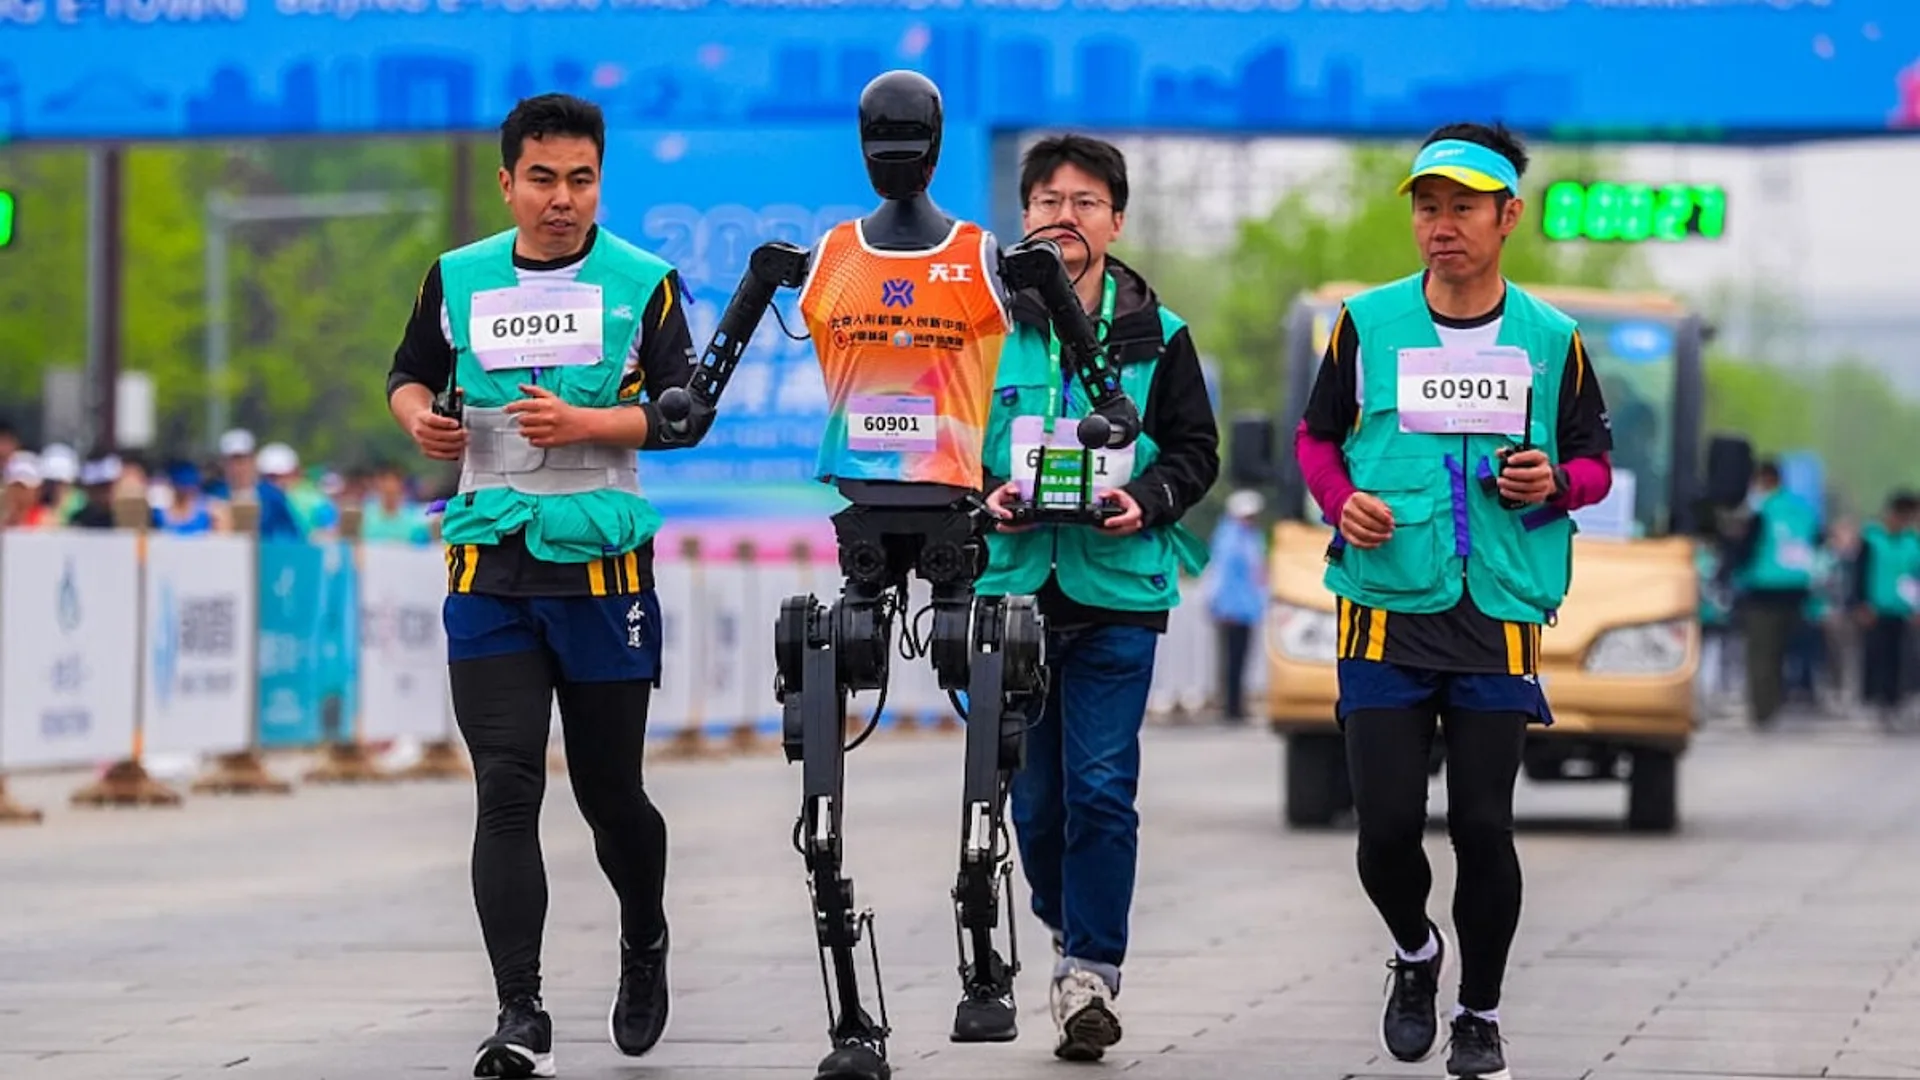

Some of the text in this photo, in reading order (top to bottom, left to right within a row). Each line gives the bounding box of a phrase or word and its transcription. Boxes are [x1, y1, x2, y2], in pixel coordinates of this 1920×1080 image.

[643, 203, 866, 286] 202
[928, 263, 972, 282] 天工
[492, 313, 578, 338] 60901
[1422, 379, 1509, 401] 60901
[864, 416, 920, 432] 60901
